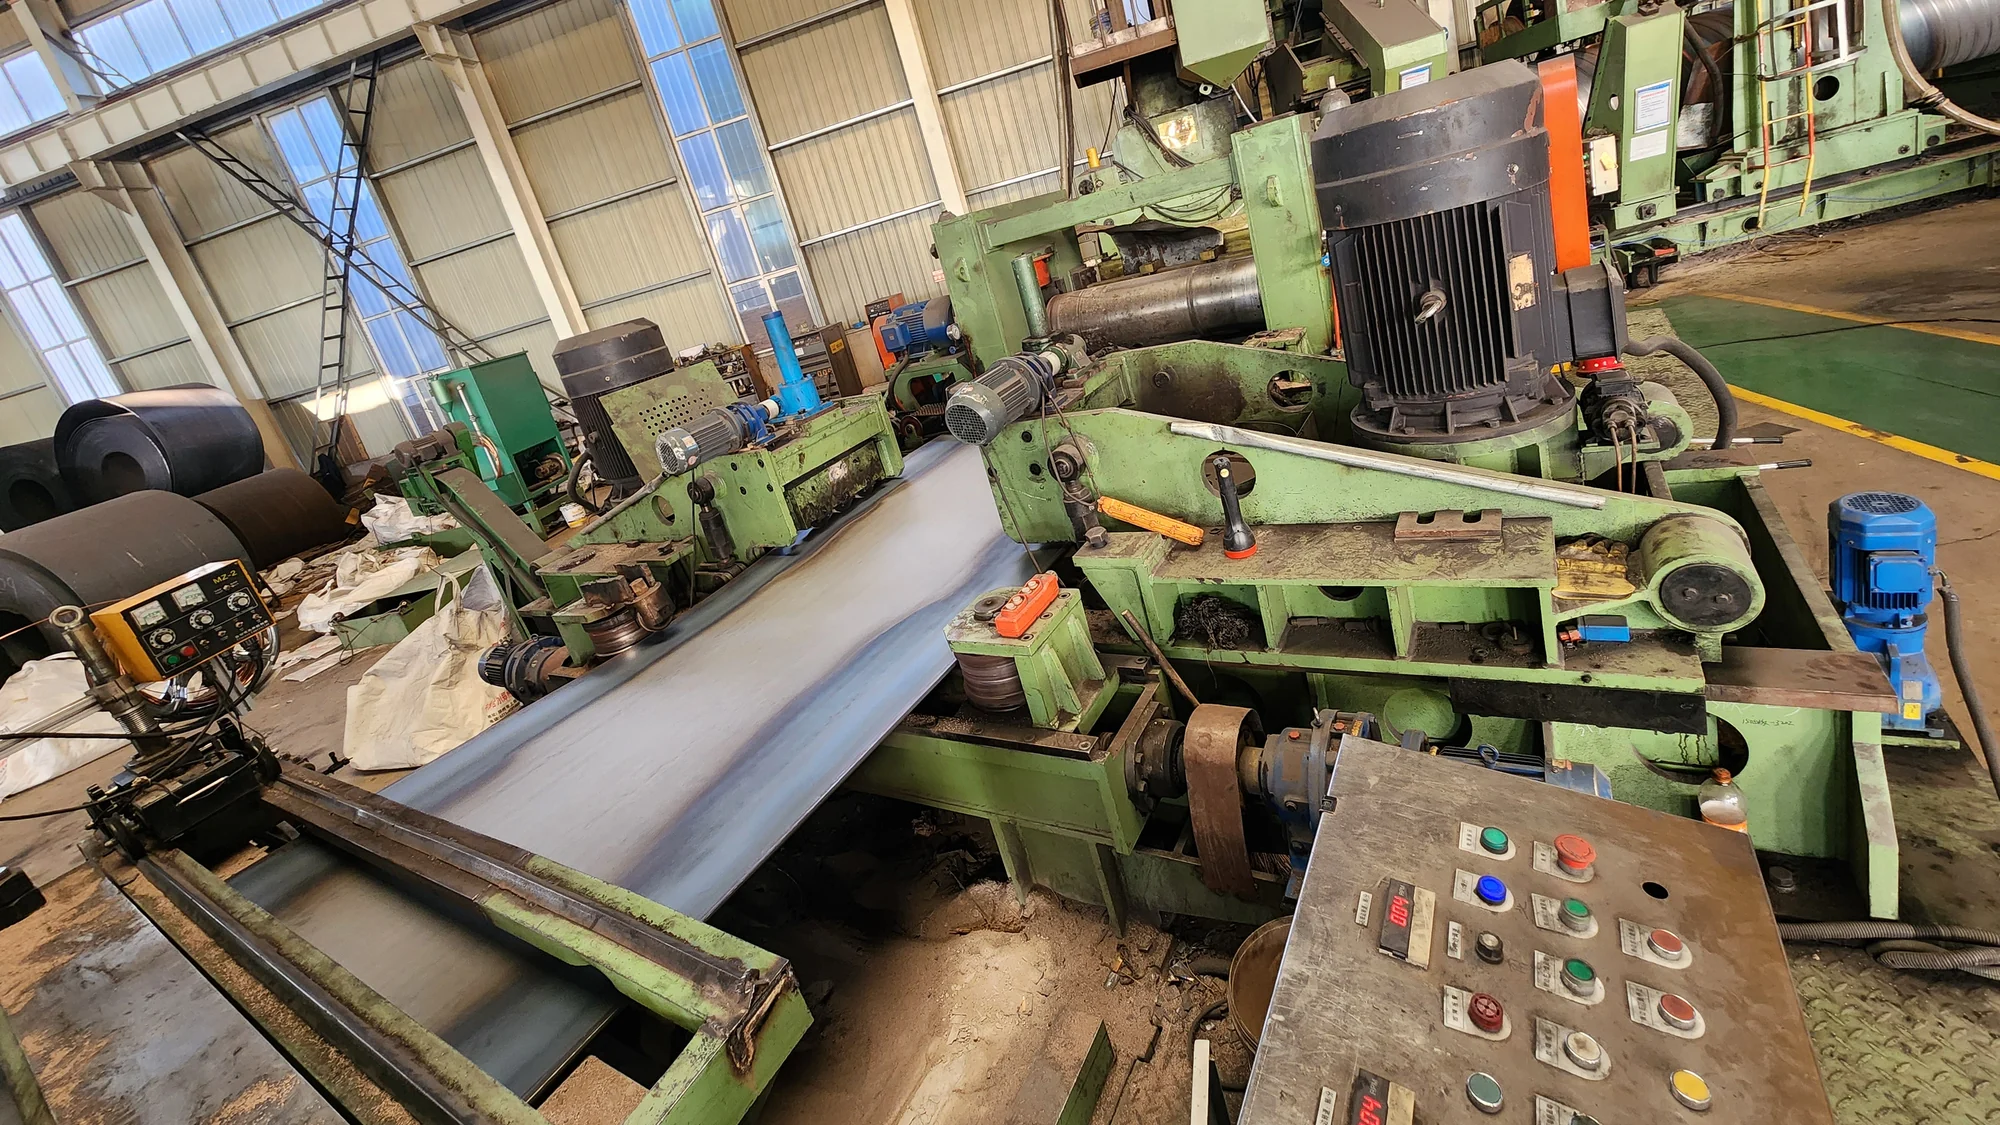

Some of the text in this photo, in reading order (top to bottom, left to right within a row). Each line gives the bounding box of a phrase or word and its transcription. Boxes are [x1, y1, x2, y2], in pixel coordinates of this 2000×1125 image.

[212, 570, 238, 584] MZ-2
[1390, 884, 1409, 927] 004 RPM
[1357, 1078, 1382, 1125] 04 RPM
